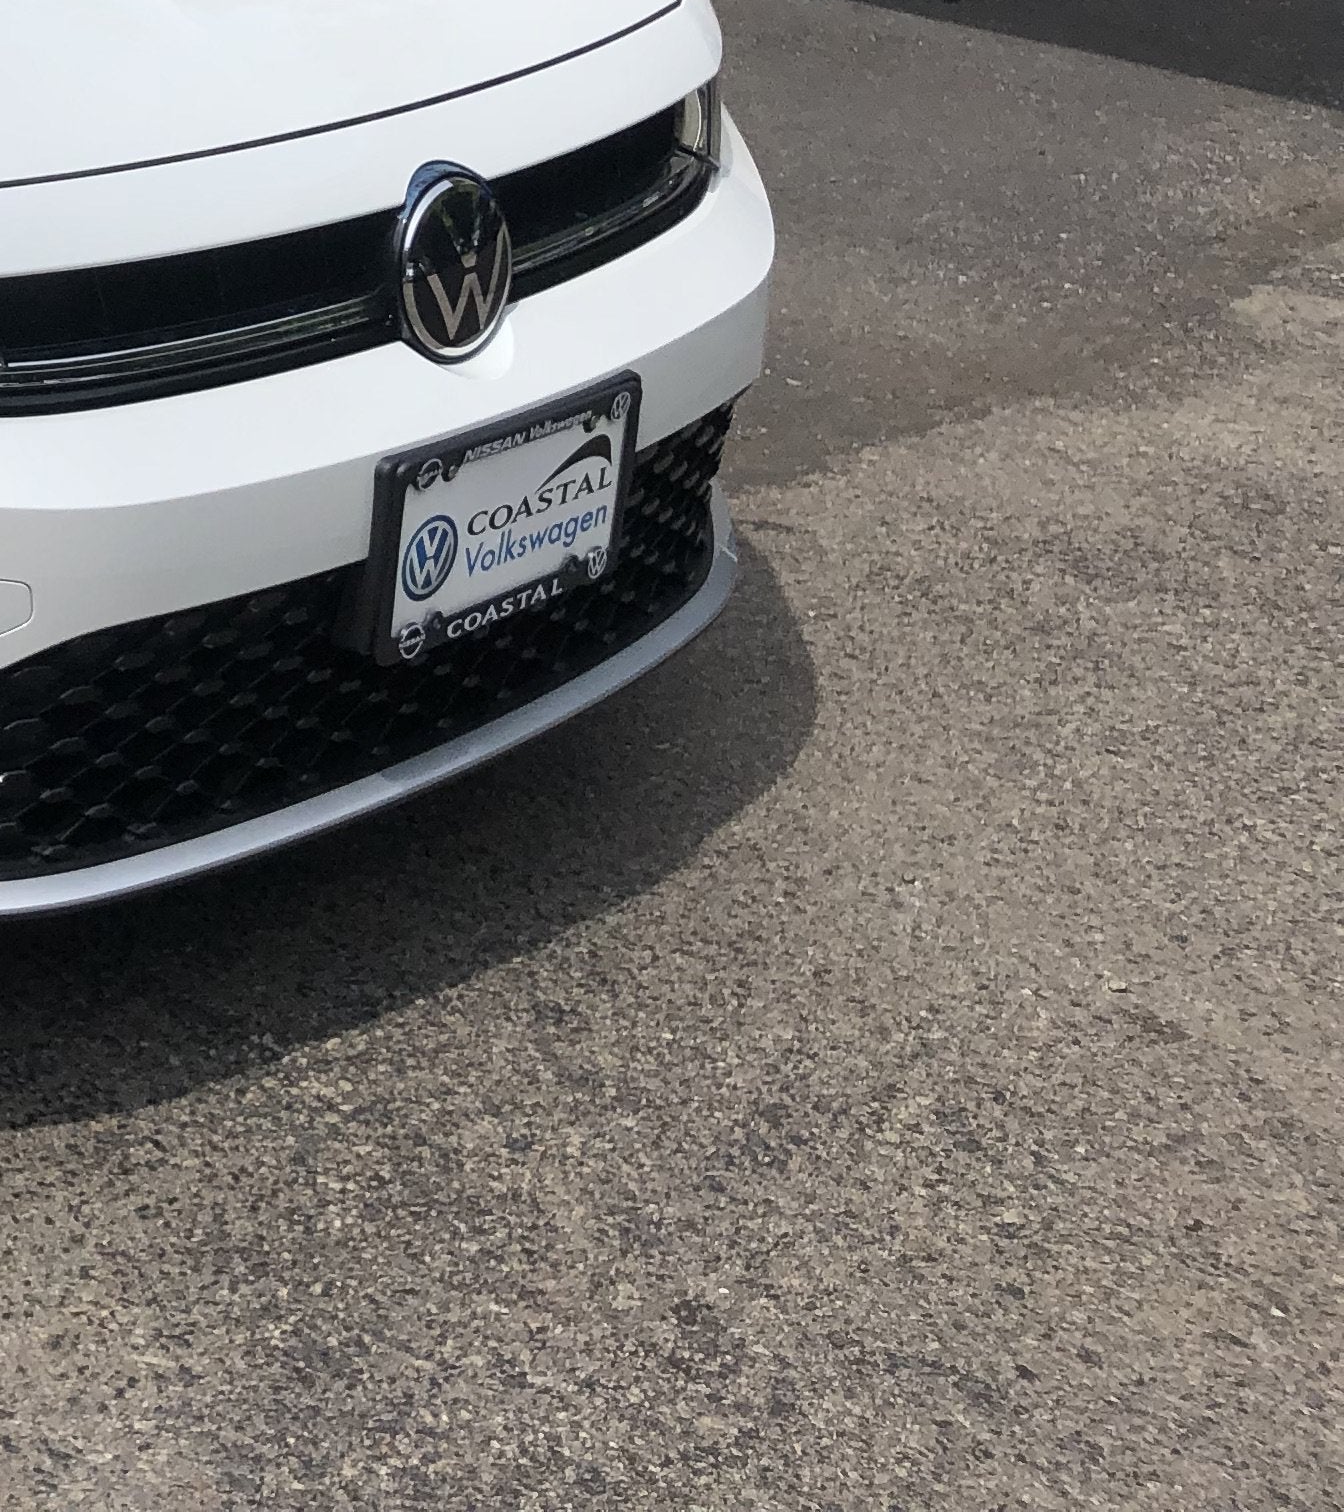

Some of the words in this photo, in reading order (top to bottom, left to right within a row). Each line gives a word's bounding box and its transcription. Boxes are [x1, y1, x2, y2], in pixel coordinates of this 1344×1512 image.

[463, 431, 527, 464] NISSAN
[466, 466, 613, 536] COASTAL
[465, 504, 608, 578] Volkswagen
[447, 577, 563, 639] COASTAL
